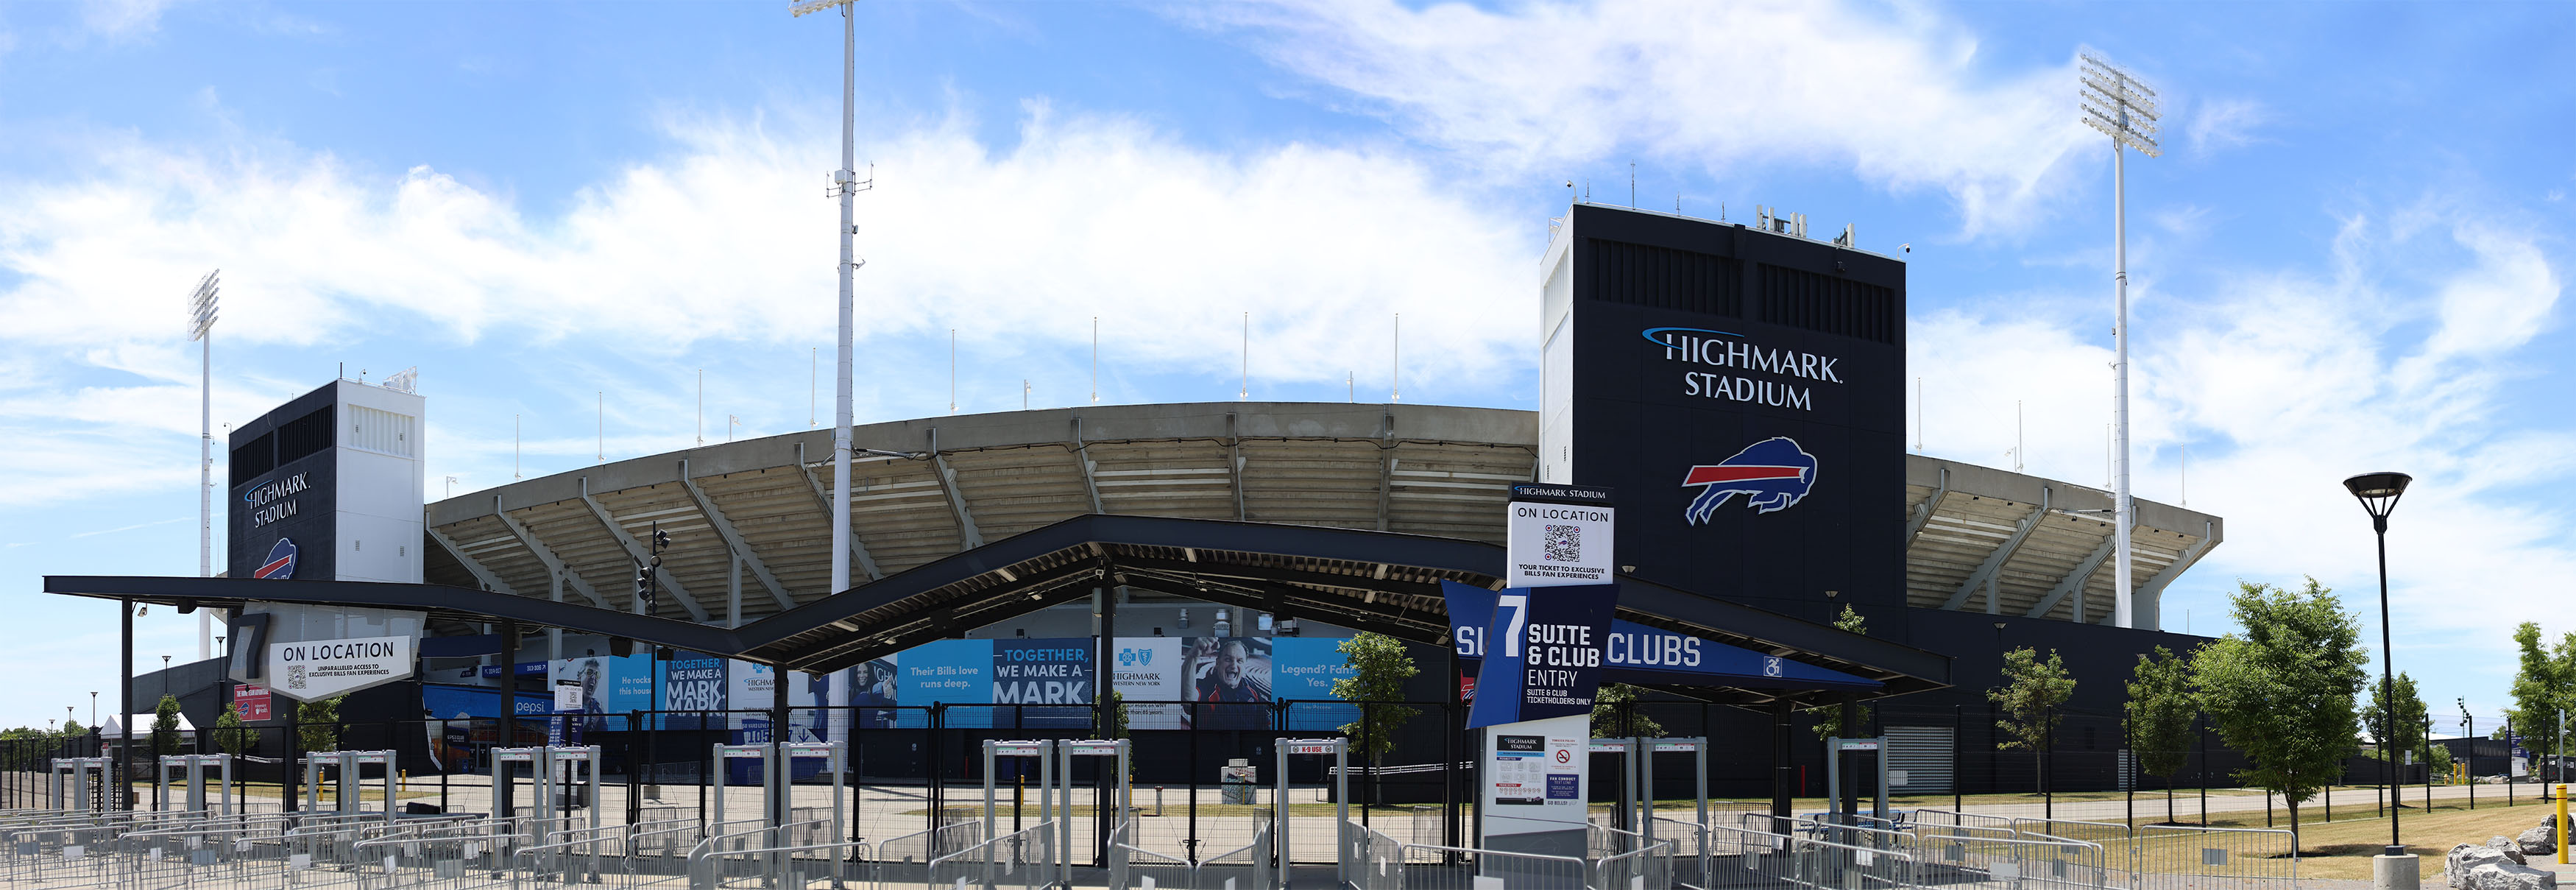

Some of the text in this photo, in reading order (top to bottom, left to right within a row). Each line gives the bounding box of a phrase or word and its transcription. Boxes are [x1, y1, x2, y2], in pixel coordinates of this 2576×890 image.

[1666, 333, 1839, 384] HIGHMARK
[1685, 371, 1811, 411] STADIUM
[250, 471, 308, 509] HIGHMARK
[1520, 487, 1606, 499] HIGHMARK STADIUM
[255, 498, 297, 528] STADIUM
[1518, 507, 1608, 522] ON LOCATION
[1498, 595, 1526, 657] 7
[1528, 624, 1591, 646] SUITE
[233, 612, 270, 679] 7
[283, 641, 394, 662] ON LOCATION
[1607, 633, 1701, 667] CLUBS
[1005, 649, 1089, 663] TOGETHER,
[1528, 646, 1600, 668] & CLUB
[671, 659, 723, 669] TOGETHER,
[910, 665, 978, 677] Their Bills love
[997, 664, 1083, 677] WE MAKE A
[1281, 664, 1354, 676] Legend? Fan?
[622, 677, 631, 685] He
[671, 669, 721, 679] WE MAKE A
[1528, 669, 1578, 687] ENTRY
[921, 679, 971, 690] runs deep.
[1306, 677, 1328, 688] Yes.
[619, 687, 631, 695] this
[666, 680, 726, 700] MARK.
[516, 702, 545, 714] pepsi
[1526, 696, 1591, 706] TICKETHOLDERS ONLY
